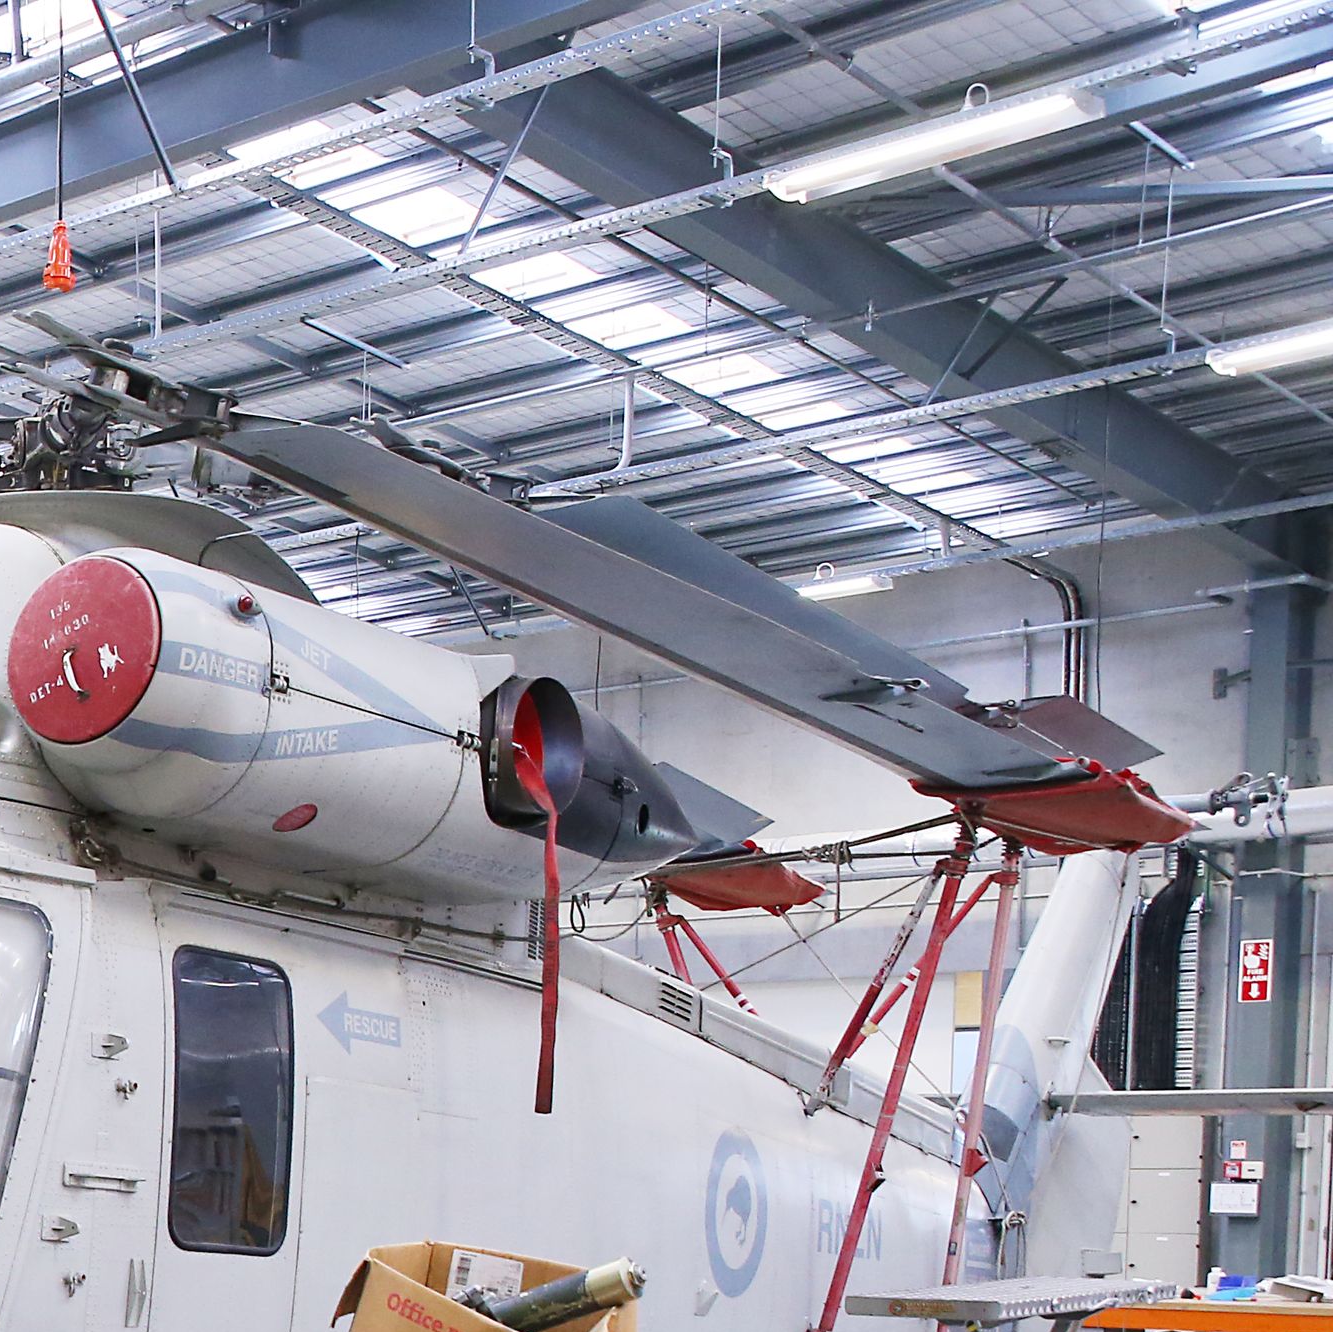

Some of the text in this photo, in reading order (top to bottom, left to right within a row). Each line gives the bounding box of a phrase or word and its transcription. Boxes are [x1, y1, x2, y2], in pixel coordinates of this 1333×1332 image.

[178, 647, 259, 689] DANGER
[300, 640, 331, 670] JET
[275, 729, 339, 756] INTAKE
[344, 1012, 398, 1041] RESCUE
[817, 1199, 882, 1262] RNN
